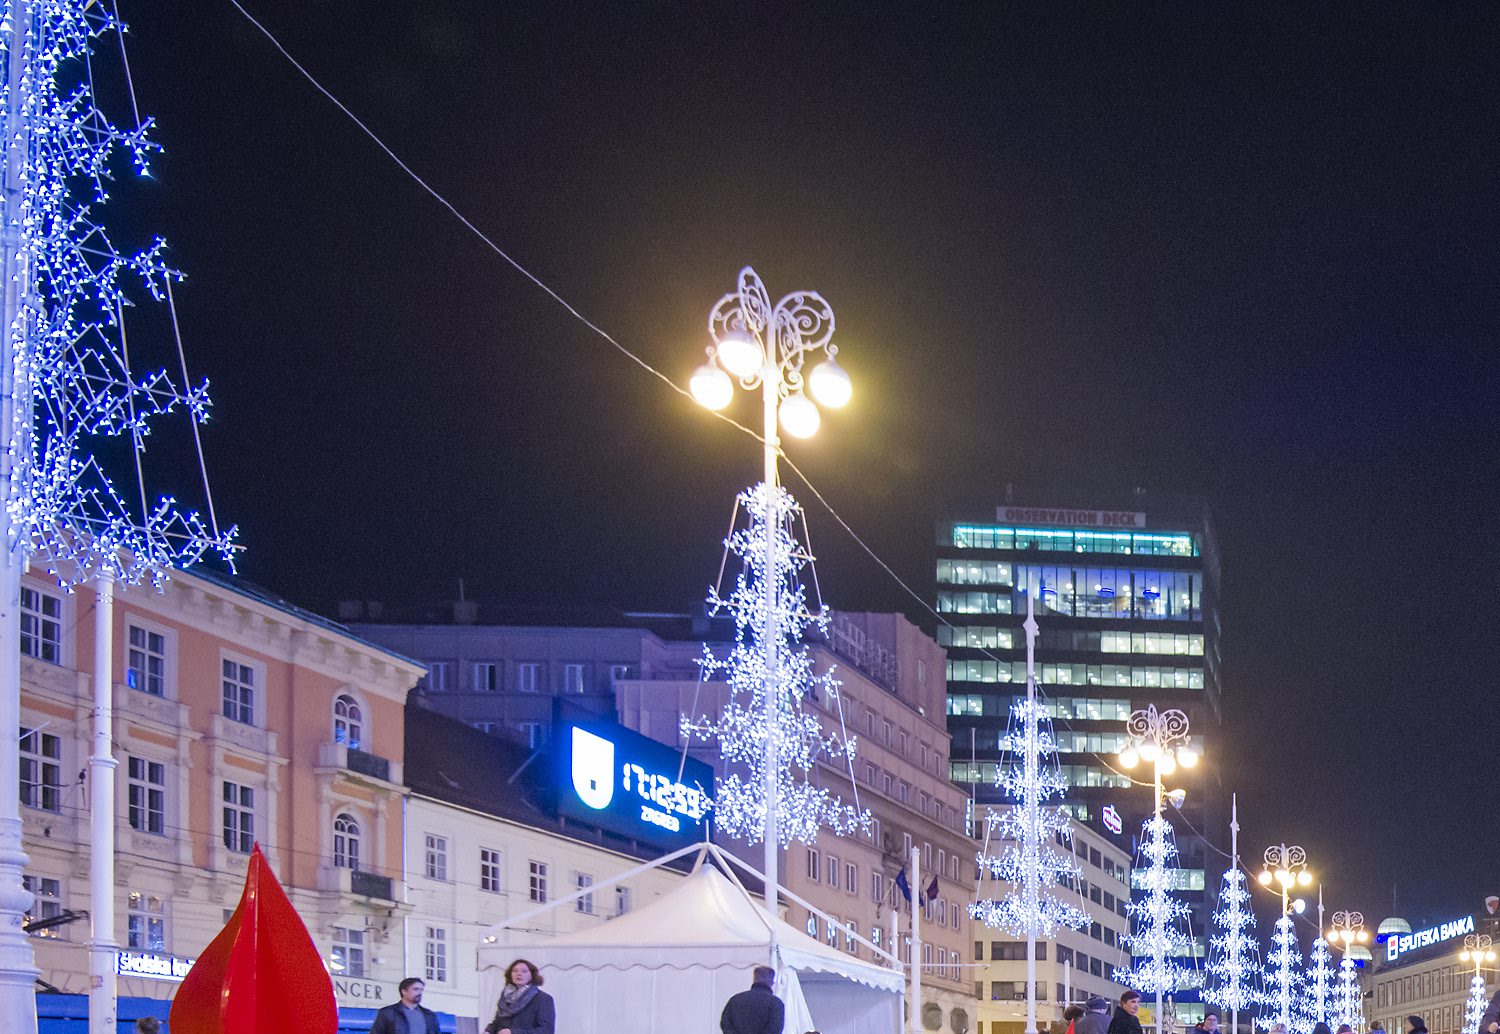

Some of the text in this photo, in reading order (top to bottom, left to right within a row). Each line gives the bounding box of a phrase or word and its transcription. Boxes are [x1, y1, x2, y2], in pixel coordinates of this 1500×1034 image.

[1004, 508, 1137, 526] OBSERVATION DECK
[1399, 915, 1475, 953] SPLITSKA BANKA
[334, 980, 383, 1001] NGER
